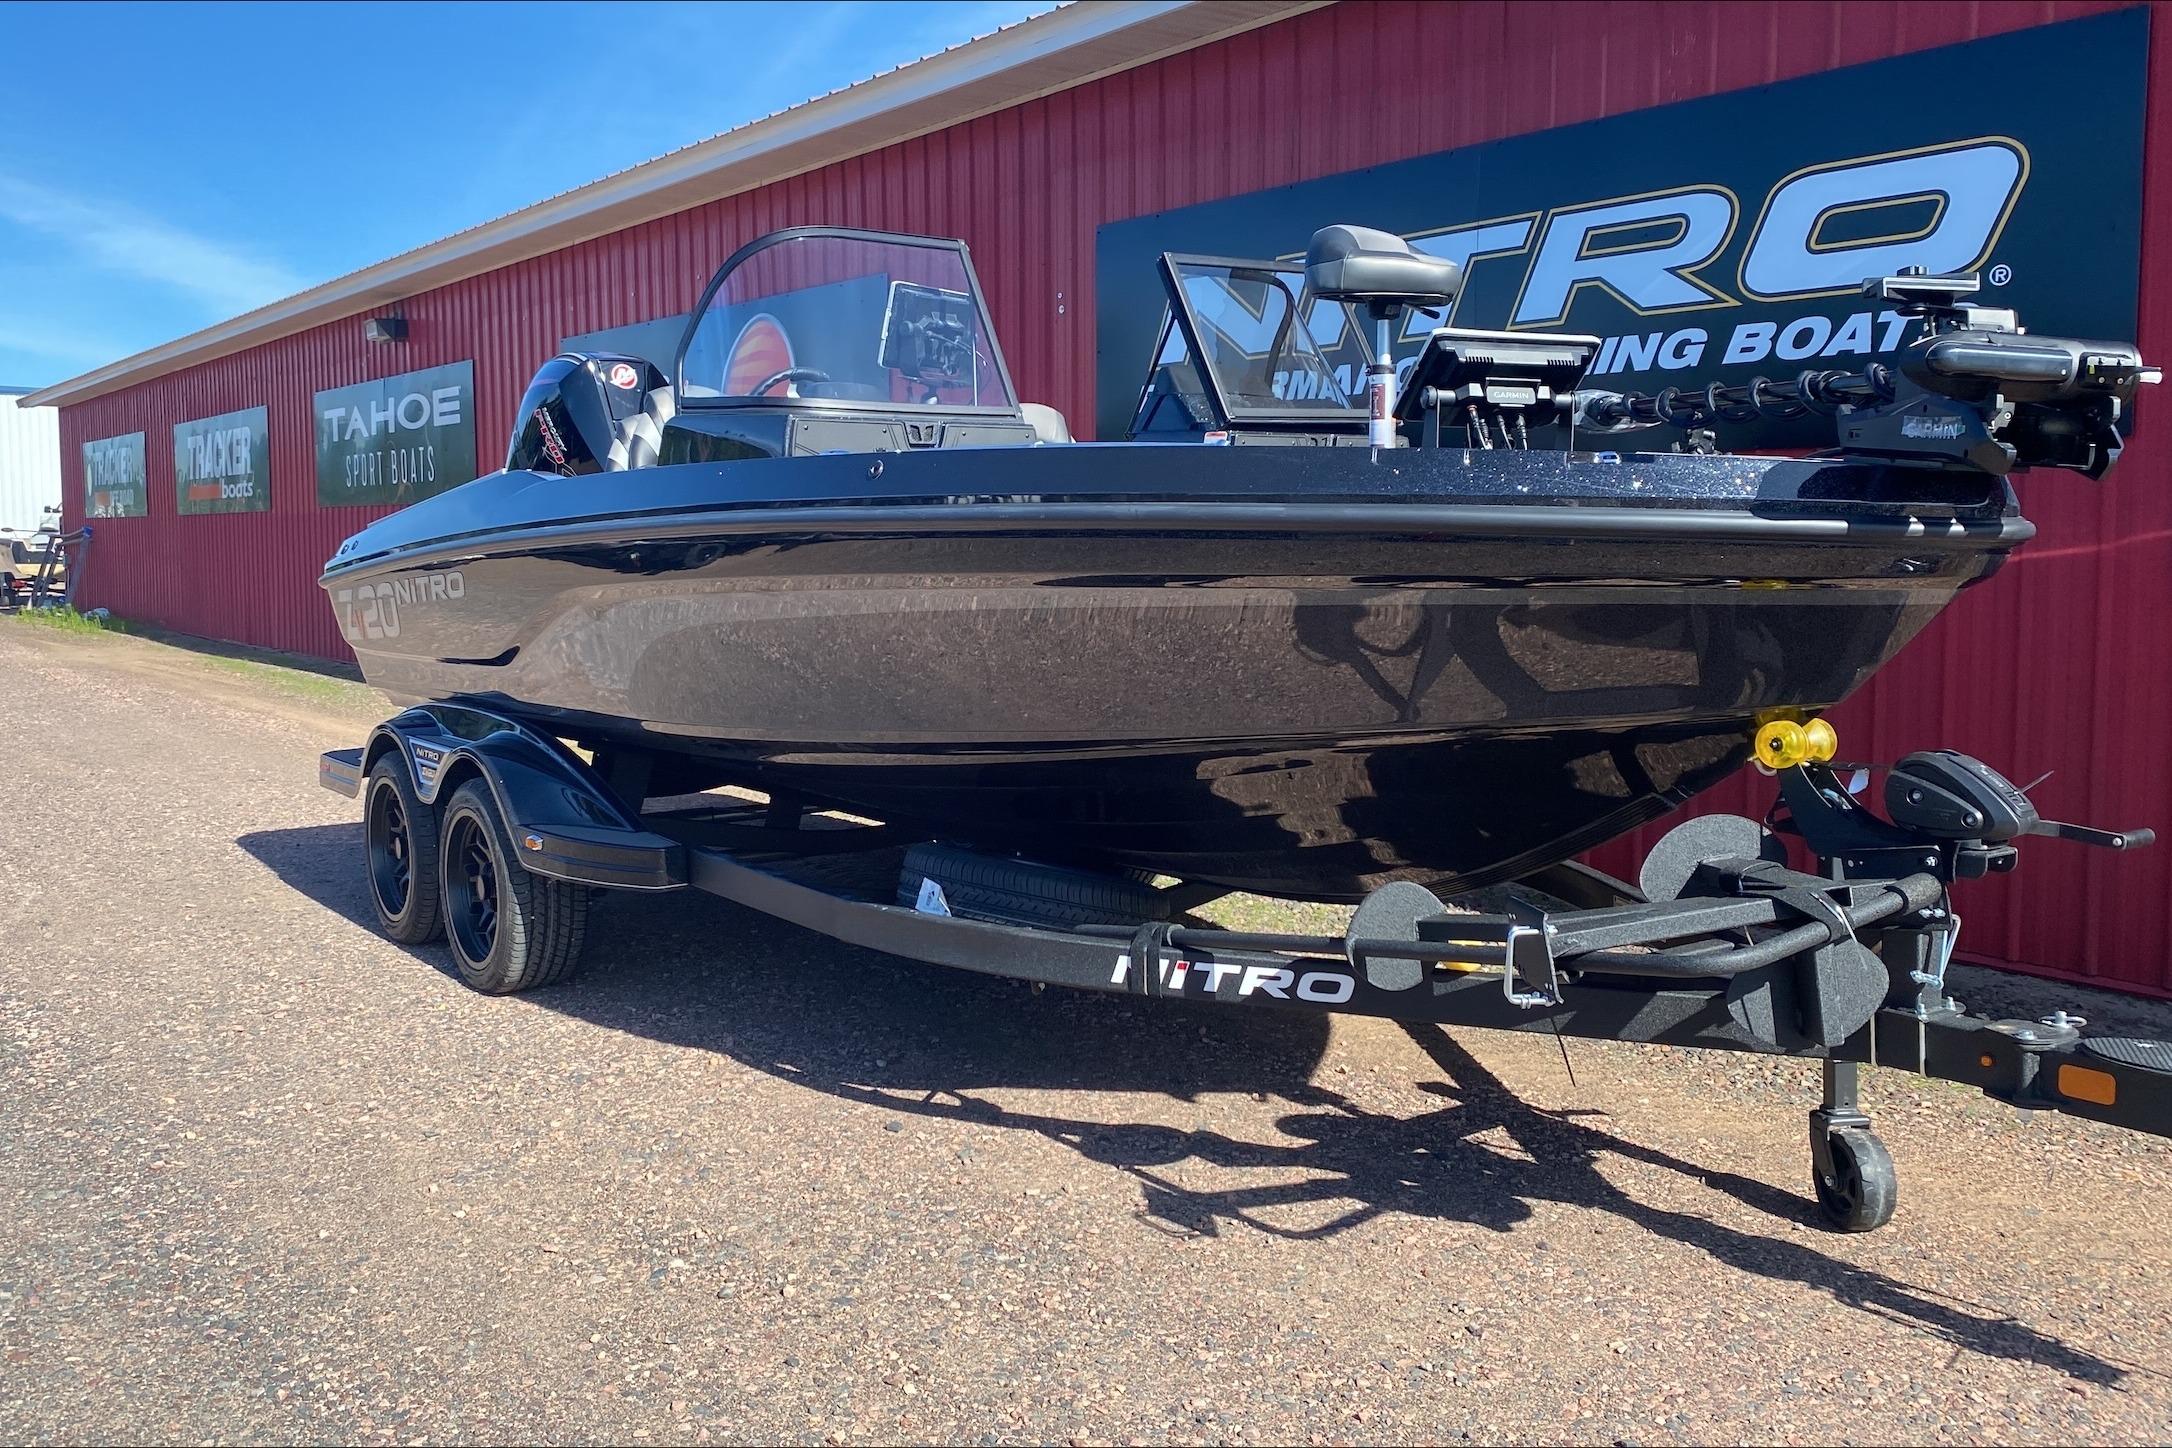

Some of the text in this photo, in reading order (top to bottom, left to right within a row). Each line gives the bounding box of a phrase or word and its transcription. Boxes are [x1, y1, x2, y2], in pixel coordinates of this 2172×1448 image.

[1722, 309, 1924, 365] BOAT
[324, 385, 461, 442] TAHOE
[1494, 391, 1529, 400] GARMIN
[94, 447, 133, 486] TRACKER
[187, 426, 252, 480] TRACKER
[346, 446, 435, 487] SPORT BOATS
[222, 478, 254, 499] boats
[394, 570, 466, 606] NITRO
[416, 747, 439, 760] NITRO
